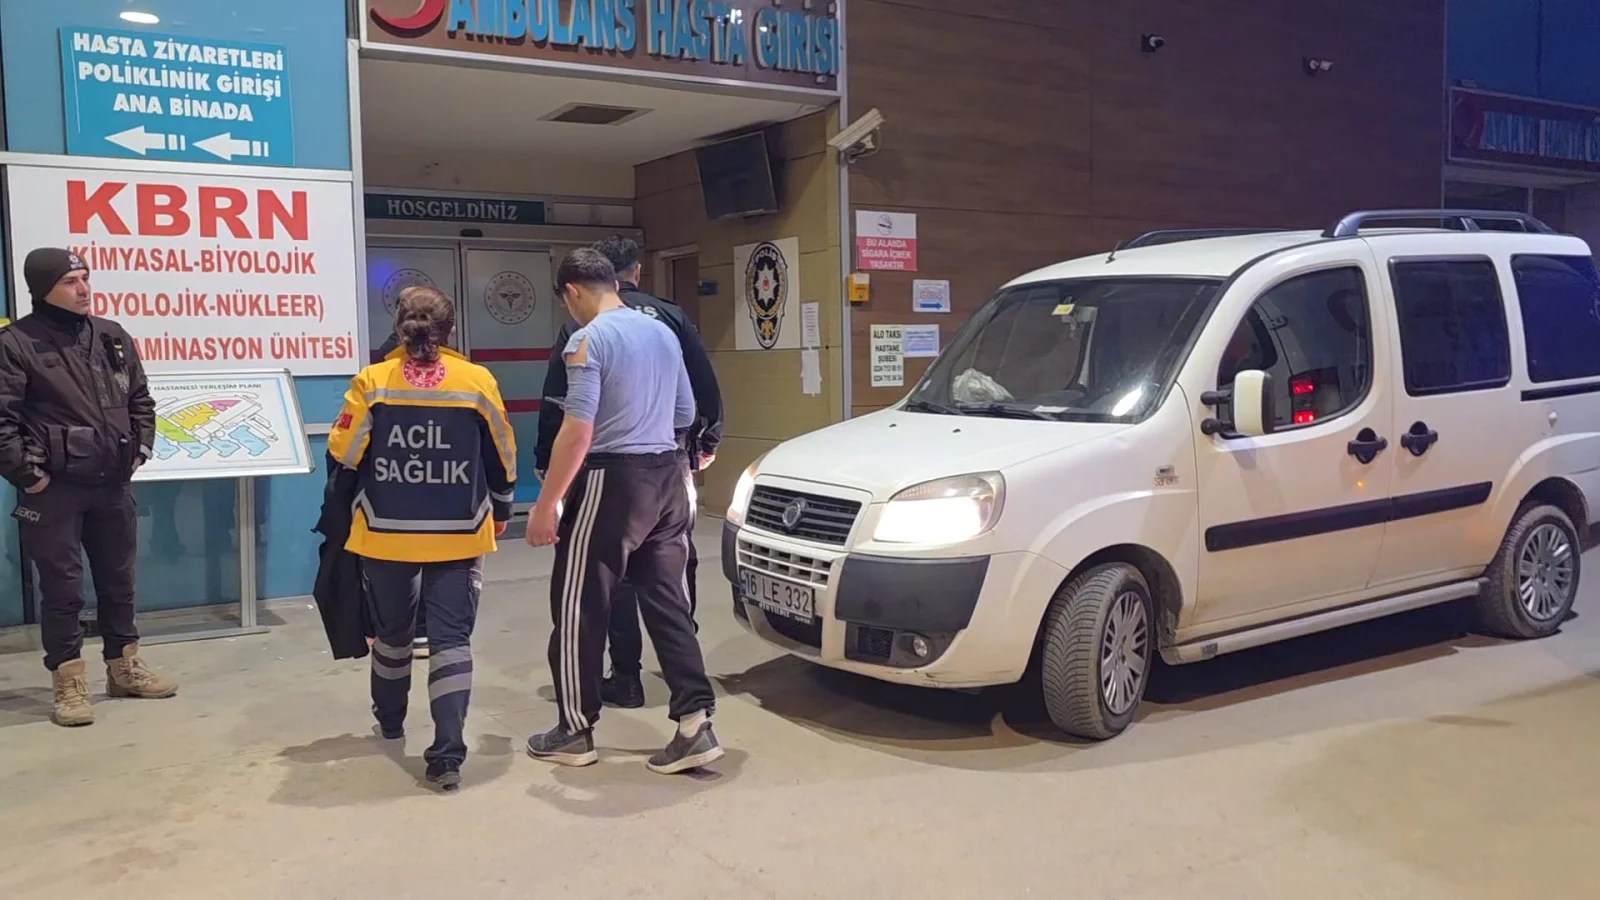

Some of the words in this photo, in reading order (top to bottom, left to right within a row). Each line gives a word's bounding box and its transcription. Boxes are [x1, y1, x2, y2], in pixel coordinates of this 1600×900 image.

[647, 0, 747, 65] HASTA
[73, 32, 147, 59] HASTA
[153, 38, 284, 71] ZİYARETLERİ
[78, 60, 210, 92] POLİKLİNİK
[216, 72, 281, 102] GİRİŞİ
[113, 93, 163, 115] ANA
[170, 95, 253, 122] BİNADA
[66, 180, 309, 241] KBRN
[387, 199, 517, 221] HOŞGELDİNİZ
[67, 240, 316, 276] KİMYASAL-BİYOLOJİK
[91, 287, 324, 322] DYOLOJİK-NÜKLEER)
[271, 331, 353, 359] ÜNİTESİ
[387, 420, 451, 449] ACİL
[375, 453, 470, 485] SAĞLIK
[746, 574, 757, 595] 16
[763, 578, 780, 603] LE
[785, 586, 809, 613] 332
